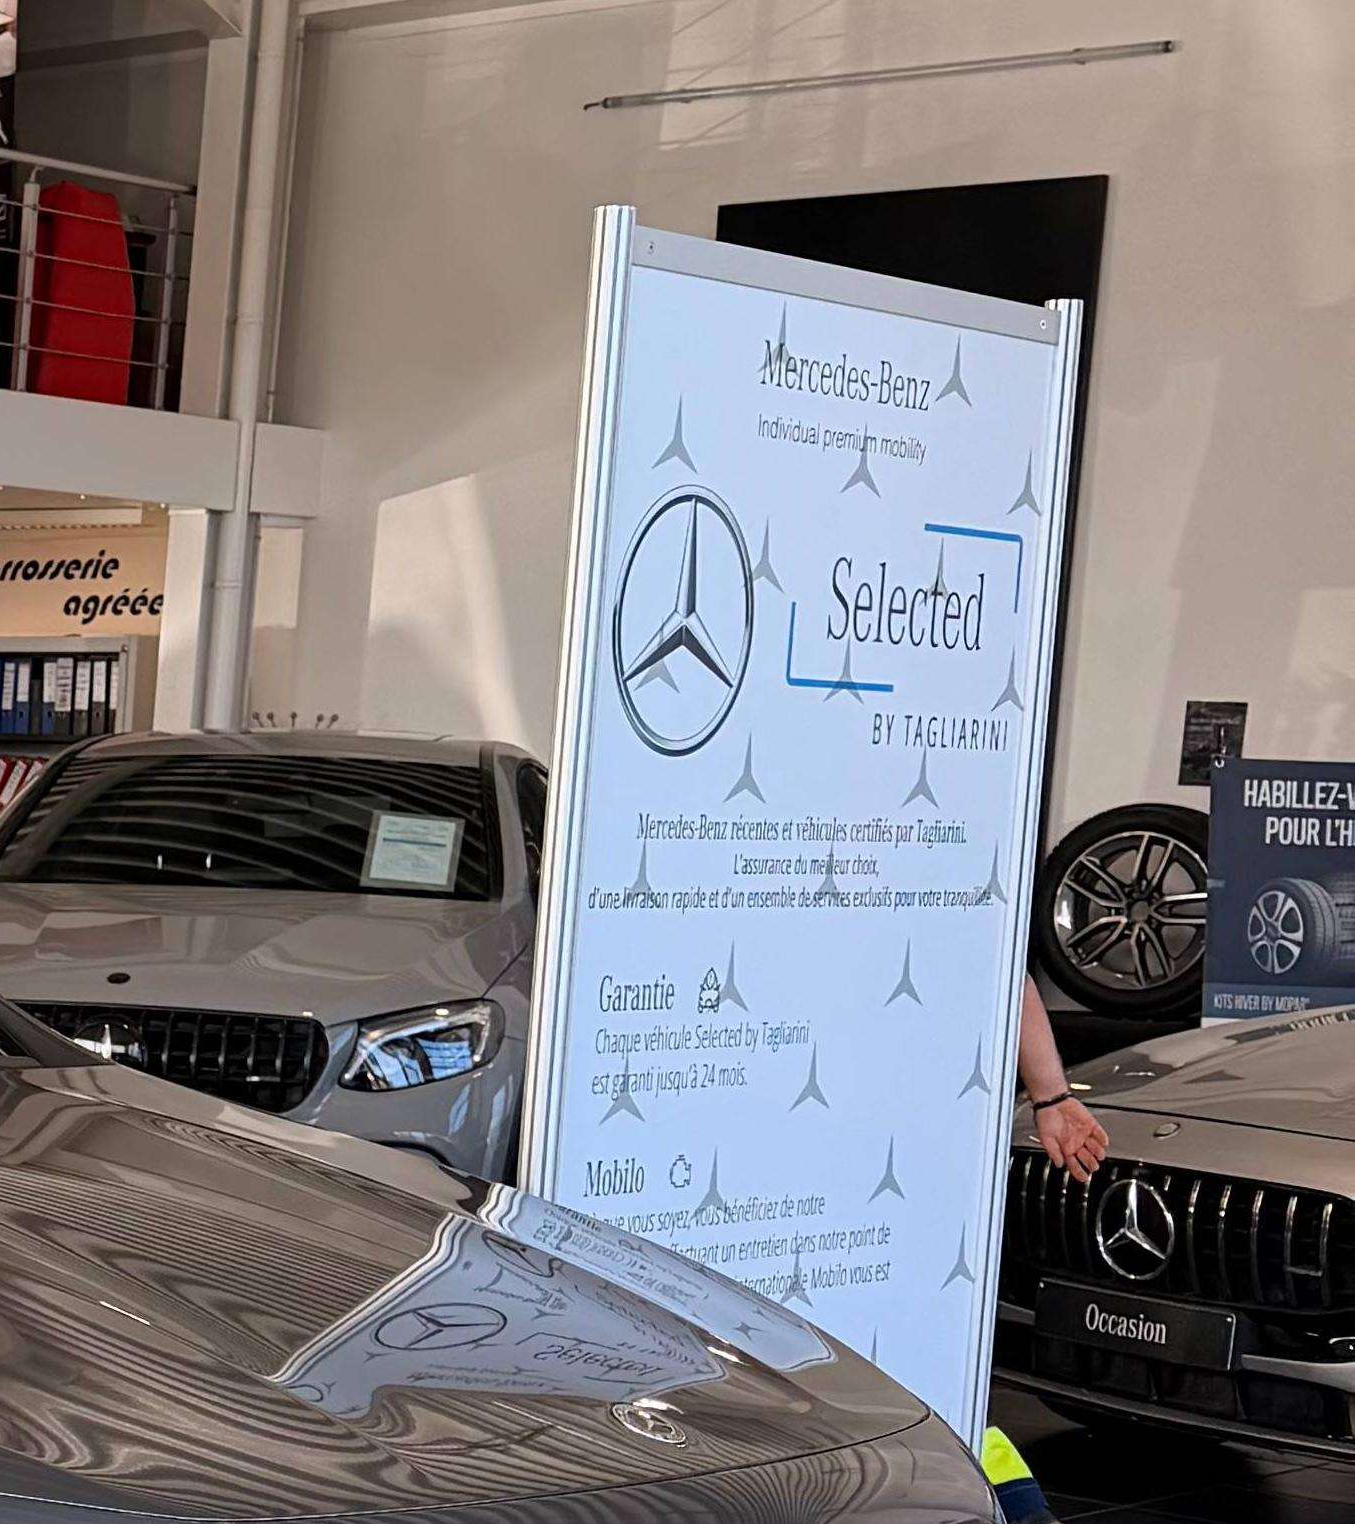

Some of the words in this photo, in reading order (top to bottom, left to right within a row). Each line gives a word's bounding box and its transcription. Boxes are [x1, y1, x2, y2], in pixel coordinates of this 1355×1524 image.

[760, 340, 930, 411] Mercedes-Benz
[758, 414, 821, 444] Individual
[823, 428, 877, 453] premium
[880, 436, 927, 466] mobility
[827, 557, 985, 650] Selected
[872, 713, 894, 745] BY
[904, 715, 1008, 751] TAGLIARINI
[637, 813, 727, 840] Mercedes-Benz
[730, 814, 779, 842] récentes
[782, 819, 793, 842] et
[796, 816, 847, 842] véhicules
[850, 817, 893, 843] certifiés
[895, 824, 914, 849] par
[916, 819, 967, 849] Tagliarini.
[1265, 816, 1320, 846] POUR
[734, 853, 792, 875] L'assurance
[794, 854, 807, 875] du
[588, 886, 620, 909] d'une
[671, 887, 706, 915] rapide
[708, 888, 719, 909] et
[721, 886, 744, 909] d'un
[747, 886, 796, 909] ensemble
[798, 886, 811, 909] de
[853, 886, 892, 909] exclusifs
[893, 889, 915, 912] pour
[918, 888, 941, 908] votre
[599, 974, 675, 1012] Garantie
[595, 1027, 640, 1059] Chaque
[644, 1025, 692, 1051] véhicule
[694, 1023, 742, 1049] Selected
[746, 1022, 759, 1053] by
[762, 1020, 810, 1053] Tagliarini
[591, 1071, 610, 1095] est
[611, 1066, 654, 1100] garanti
[655, 1063, 698, 1097] jusqu'à
[700, 1063, 715, 1088] 24
[718, 1061, 748, 1087] mois.
[583, 1157, 645, 1197] Mobilo
[627, 1210, 656, 1234] vous
[658, 1209, 691, 1238] soyez,
[694, 1205, 722, 1227] vous
[723, 1195, 777, 1224] bénéficiez
[780, 1193, 794, 1218] de
[796, 1193, 826, 1217] notre
[721, 1242, 736, 1264] un
[738, 1232, 788, 1261] entretien
[791, 1230, 816, 1255] dans
[818, 1229, 847, 1251] notre
[848, 1223, 876, 1255] point
[877, 1221, 891, 1246] de
[810, 1262, 847, 1290] Mobilo
[850, 1263, 873, 1284] vous
[875, 1260, 892, 1283] est
[1085, 1303, 1167, 1345] Occasion
